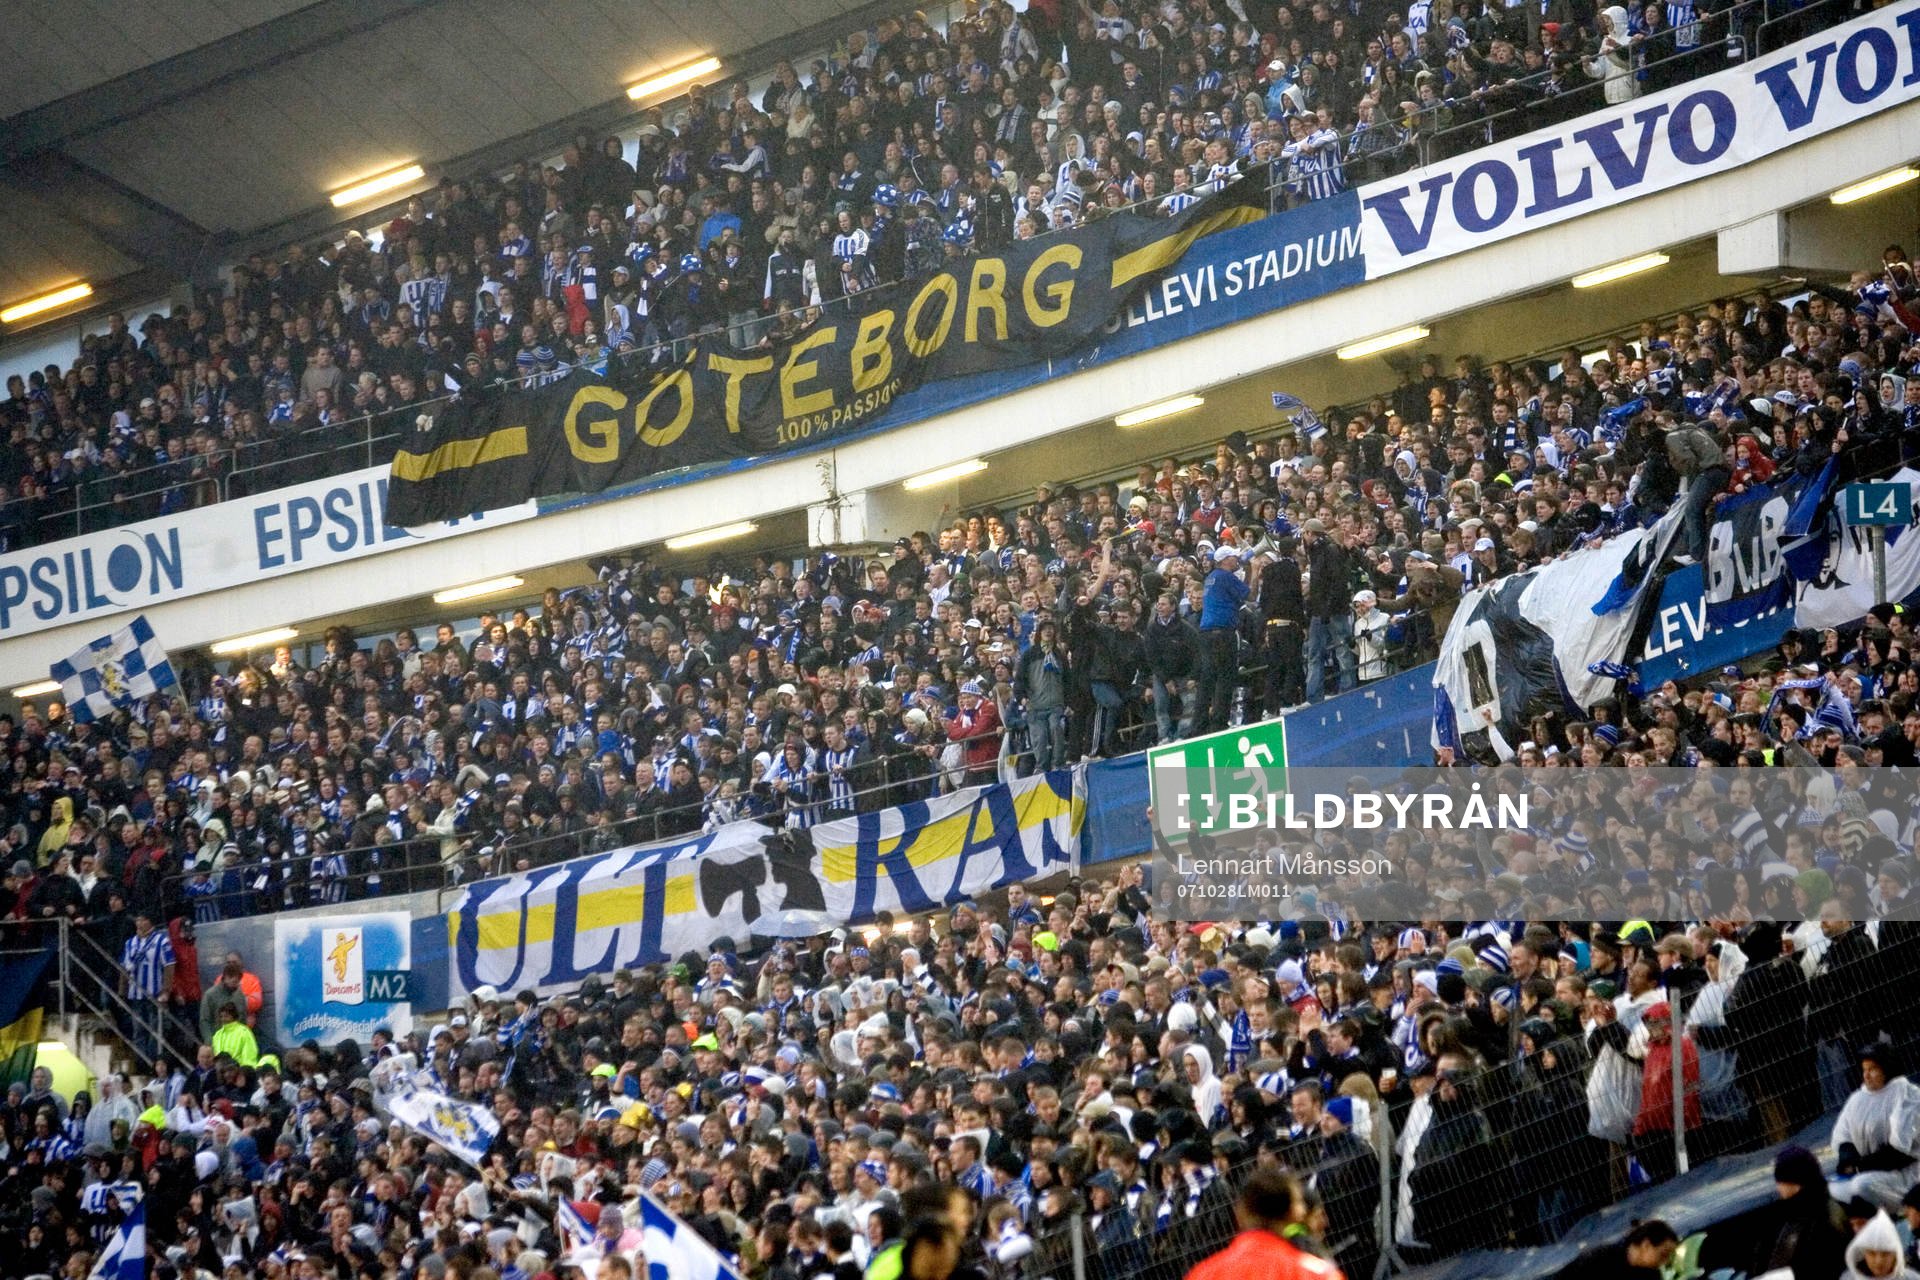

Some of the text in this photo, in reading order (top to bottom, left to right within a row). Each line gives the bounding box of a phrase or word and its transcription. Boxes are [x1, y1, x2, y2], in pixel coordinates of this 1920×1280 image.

[1363, 89, 1737, 257] VOLVO
[1224, 222, 1364, 297] STADIUM
[563, 244, 1083, 464] GÖTEBORG
[254, 477, 484, 570] EPSIL
[1858, 488, 1898, 519] L4
[369, 974, 407, 999] M2
